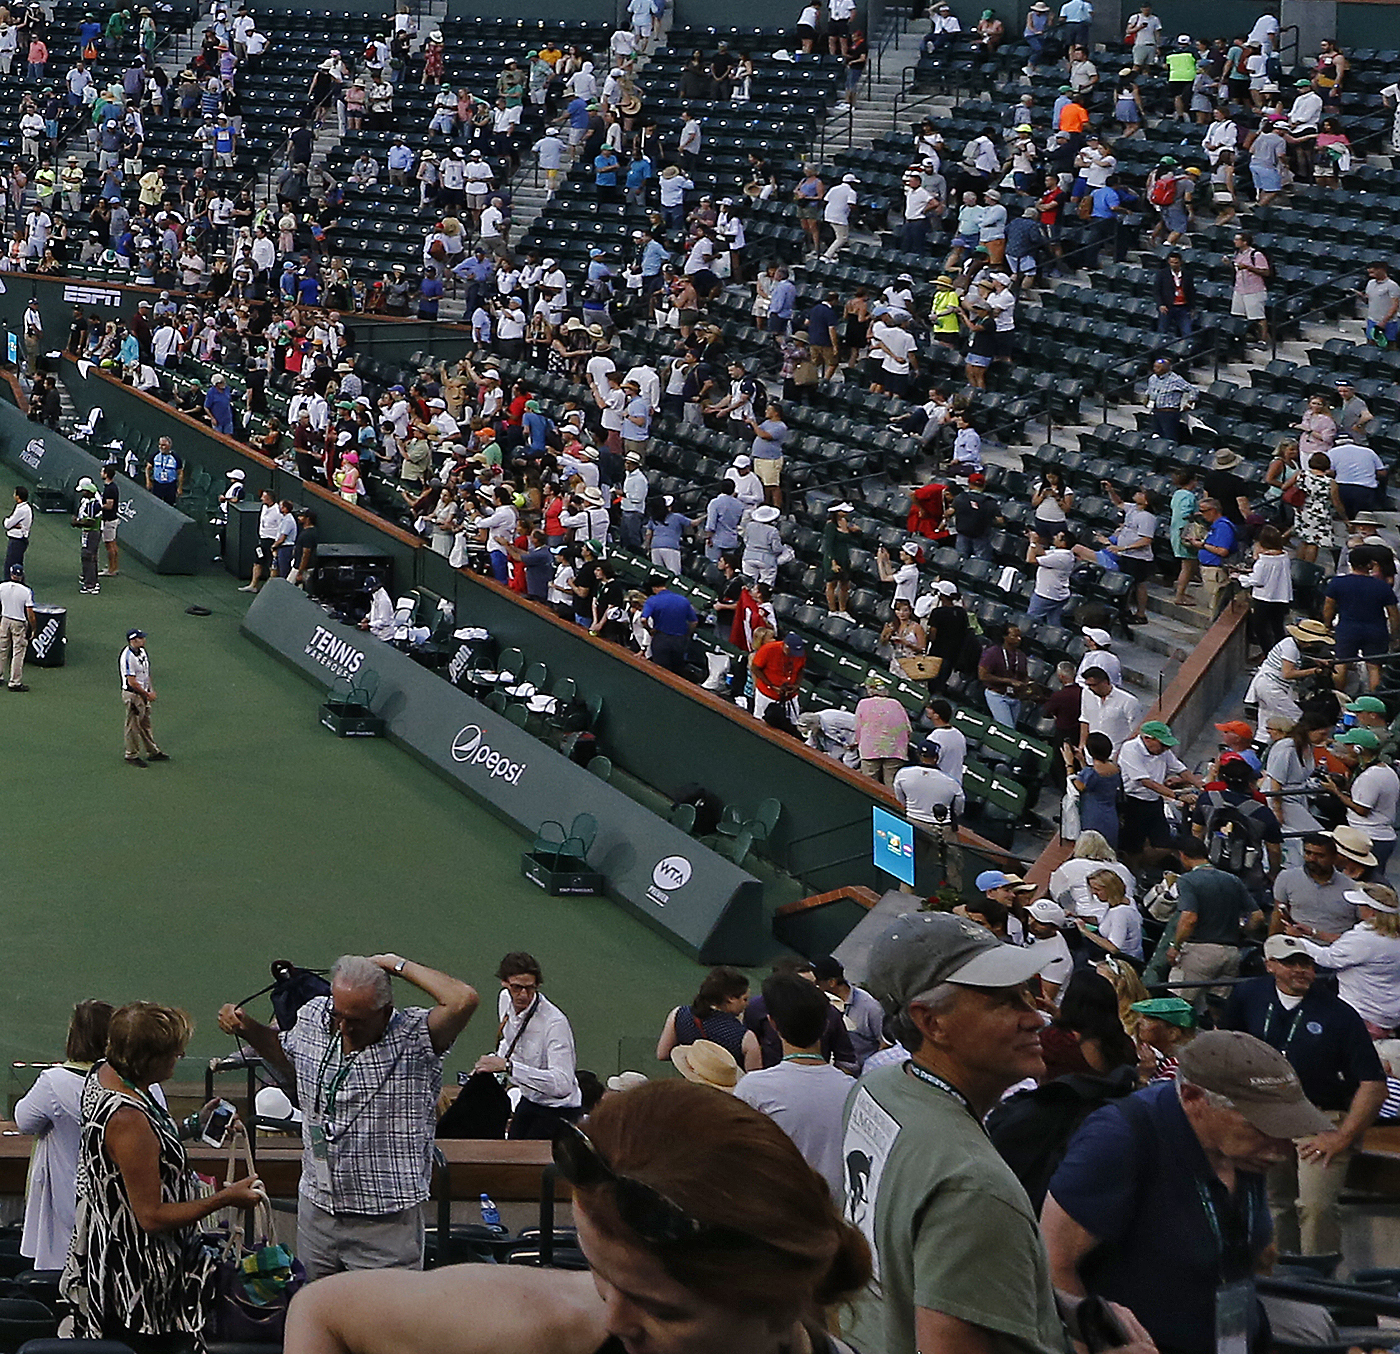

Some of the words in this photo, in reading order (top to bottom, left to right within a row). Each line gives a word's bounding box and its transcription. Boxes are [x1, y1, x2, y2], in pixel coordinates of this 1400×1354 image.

[63, 284, 122, 307] ESPN
[308, 625, 366, 674] TENNIS
[471, 744, 528, 787] pepsi
[659, 861, 685, 885] WTA
